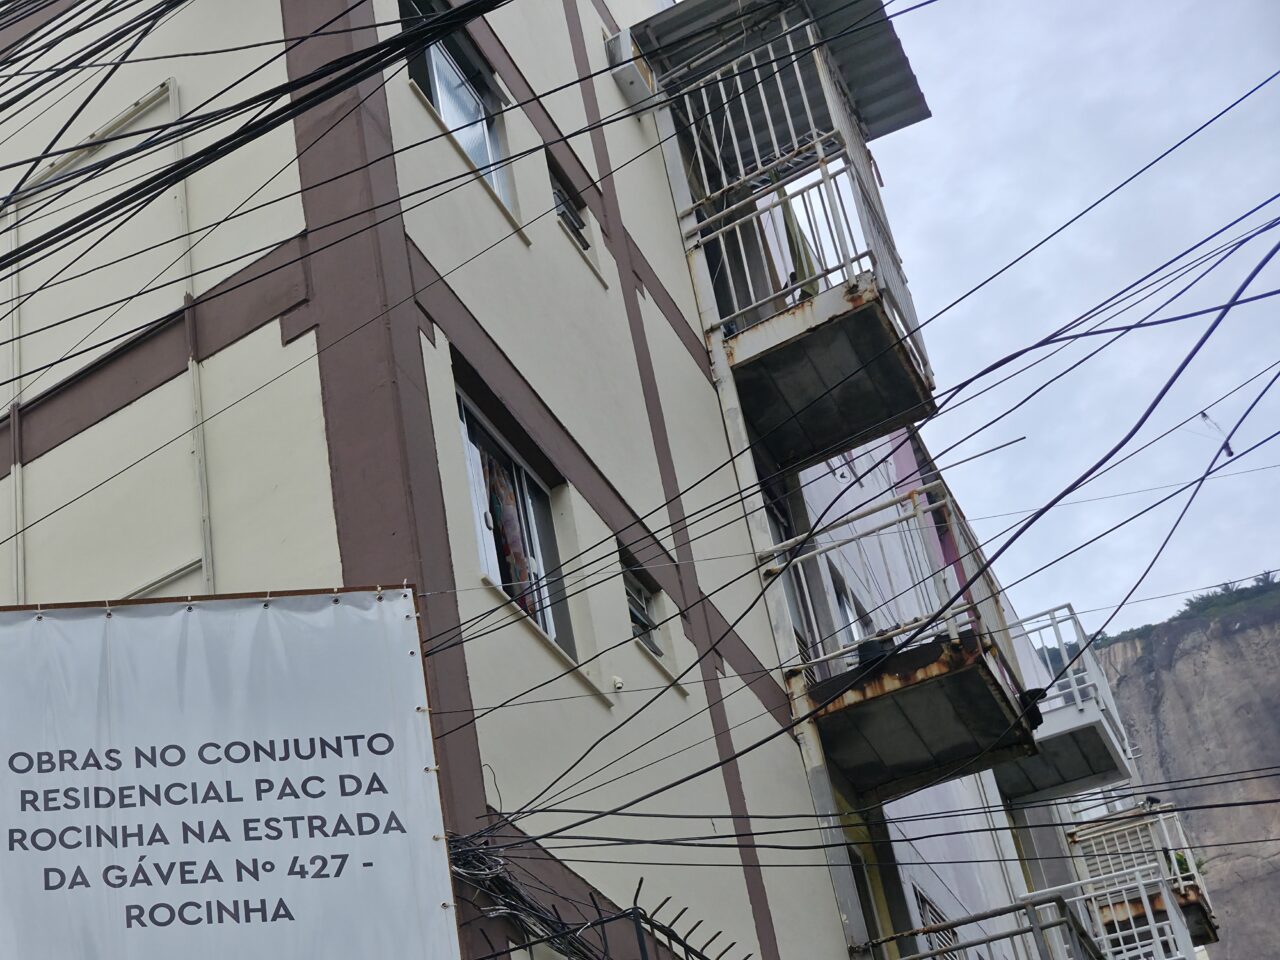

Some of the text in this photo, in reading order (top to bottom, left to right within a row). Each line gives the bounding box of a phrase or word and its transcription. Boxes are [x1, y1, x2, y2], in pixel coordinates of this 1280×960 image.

[8, 732, 395, 774] OBRAS NO CONJUNTO
[20, 772, 389, 812] RESIDENCIAL PAC DA
[7, 810, 407, 852] ROCINHA NA ESTRADA
[43, 865, 91, 891] DA
[102, 855, 224, 889] GÁVEA
[287, 853, 350, 880] 427
[125, 897, 295, 929] ROCINHA
